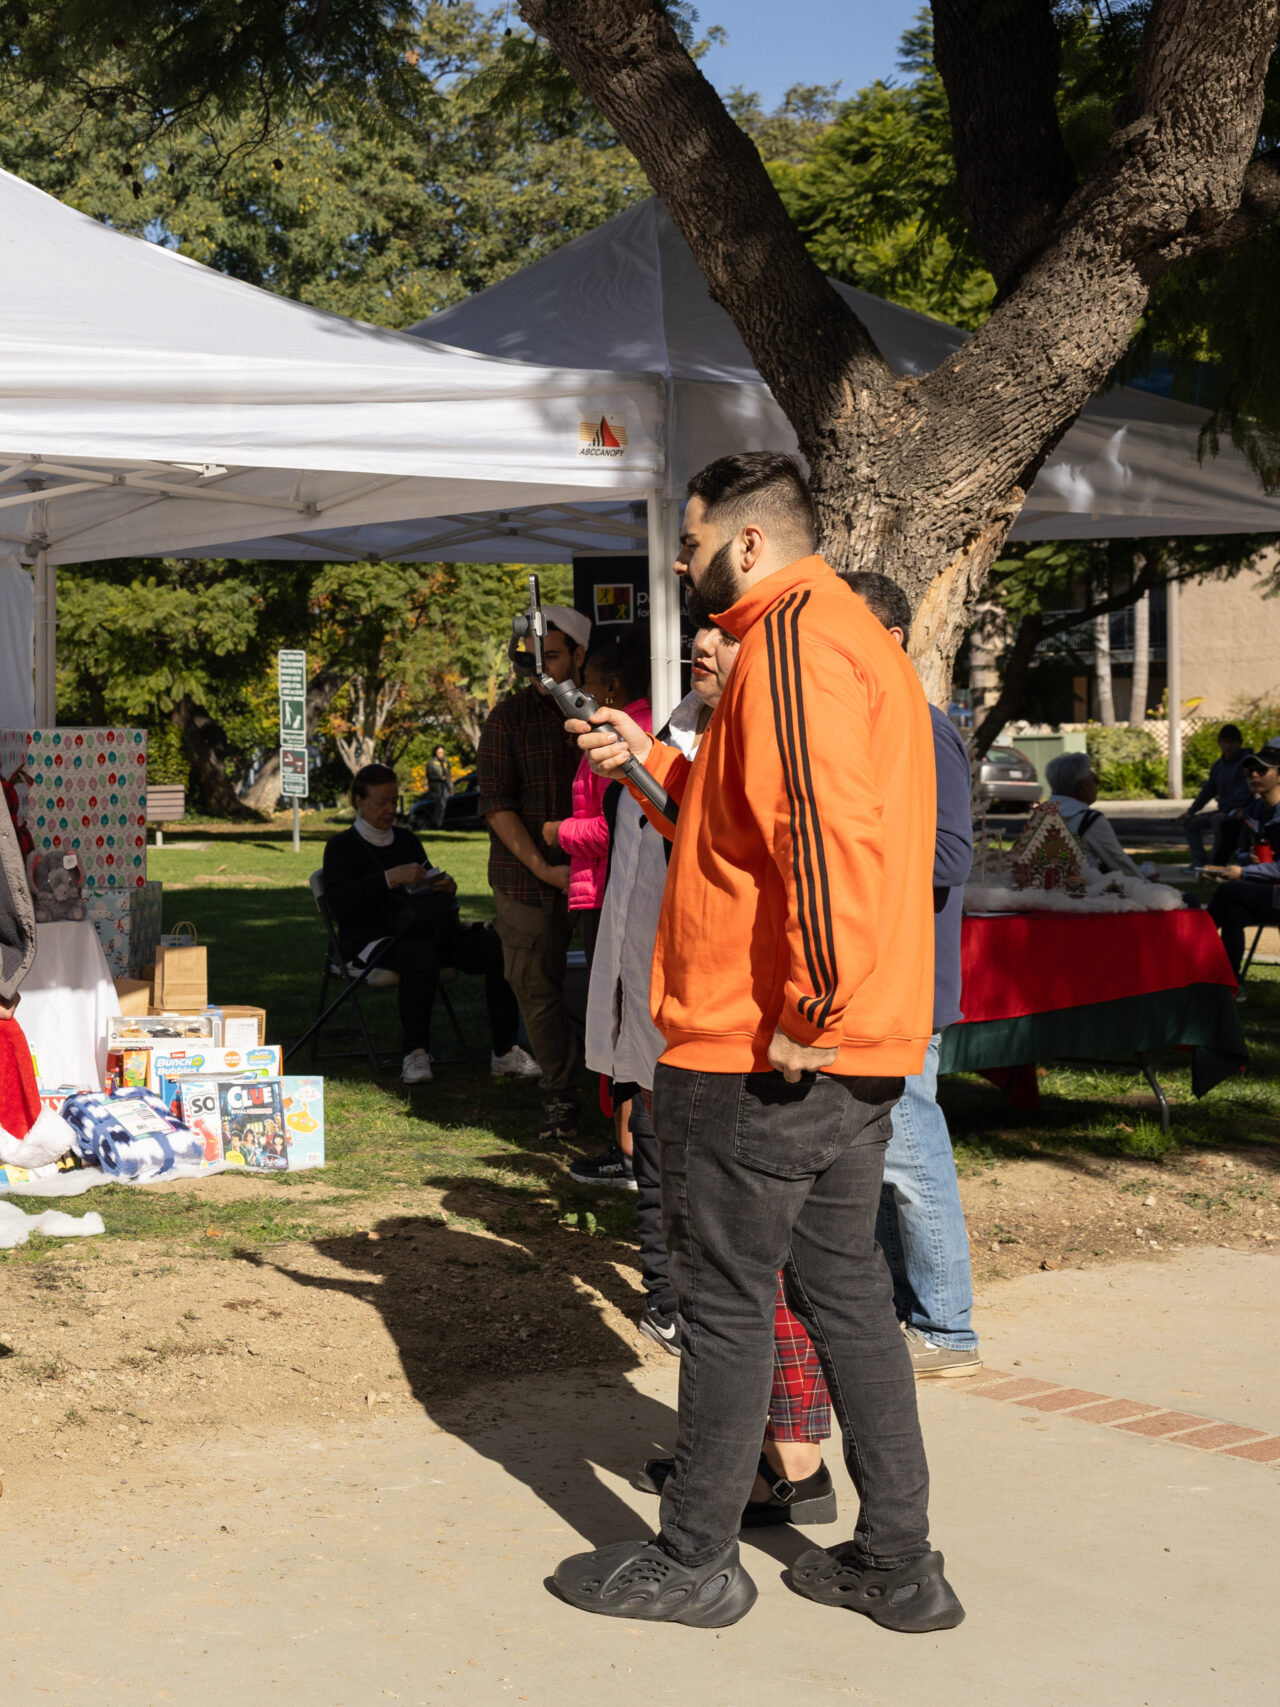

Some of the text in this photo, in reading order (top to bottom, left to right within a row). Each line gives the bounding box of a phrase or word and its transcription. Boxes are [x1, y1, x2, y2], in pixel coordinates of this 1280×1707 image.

[579, 447, 625, 457] ABCCANOPY
[227, 1085, 274, 1109] CLUE
[599, 1163, 624, 1173] HOKA
